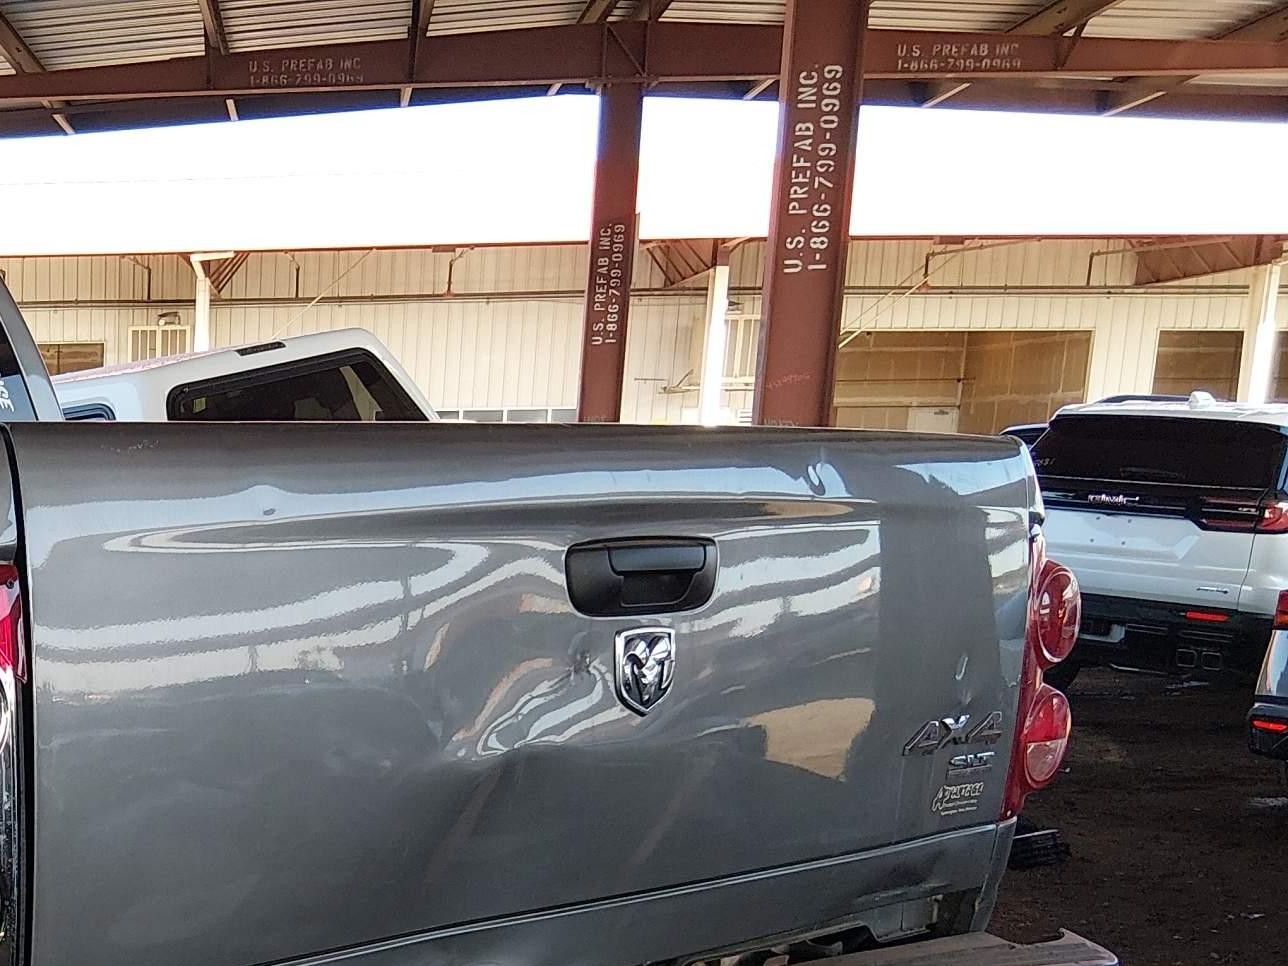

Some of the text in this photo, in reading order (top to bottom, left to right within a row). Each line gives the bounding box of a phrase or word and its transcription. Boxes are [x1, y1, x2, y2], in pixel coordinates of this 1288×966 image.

[249, 60, 274, 73] U.S.
[281, 58, 333, 72] PREFAB
[896, 43, 924, 57] U.S.
[932, 43, 989, 57] PREFAB
[783, 63, 819, 273] U.S. PREFAB INC.
[808, 64, 843, 270] 1-866-799-0969
[591, 223, 612, 345] U.S. PREFAB INC.
[605, 224, 625, 343] 1-866-799-0969
